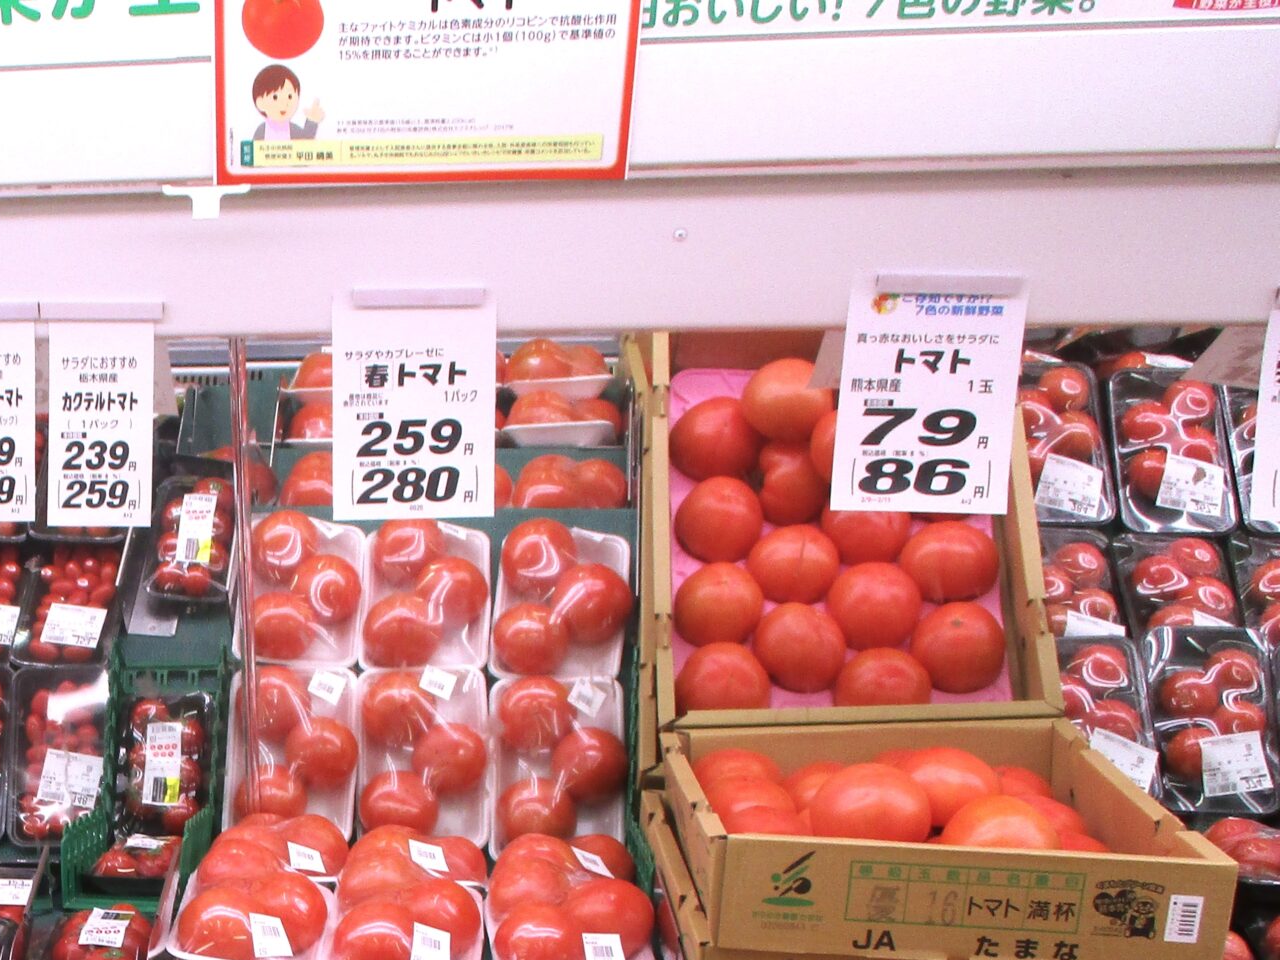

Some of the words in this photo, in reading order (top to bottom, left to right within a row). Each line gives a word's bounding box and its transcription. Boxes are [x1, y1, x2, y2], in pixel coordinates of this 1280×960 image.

[857, 333, 1000, 345] 真っ赤なおいしさをサラダに
[61, 356, 138, 370] サラダにおすすめ
[364, 361, 467, 388] 春トマト
[894, 348, 971, 374] トマト
[850, 378, 902, 393] 熊本県産
[62, 391, 139, 413] カクテルトマト
[356, 418, 463, 458] 259
[860, 407, 978, 447] 79
[62, 440, 130, 471] 239
[356, 465, 460, 505] 280
[858, 458, 970, 496] 86
[61, 480, 130, 509] 259
[967, 895, 1021, 919] トマト
[1026, 900, 1077, 923] 満杯
[852, 929, 896, 952] JA
